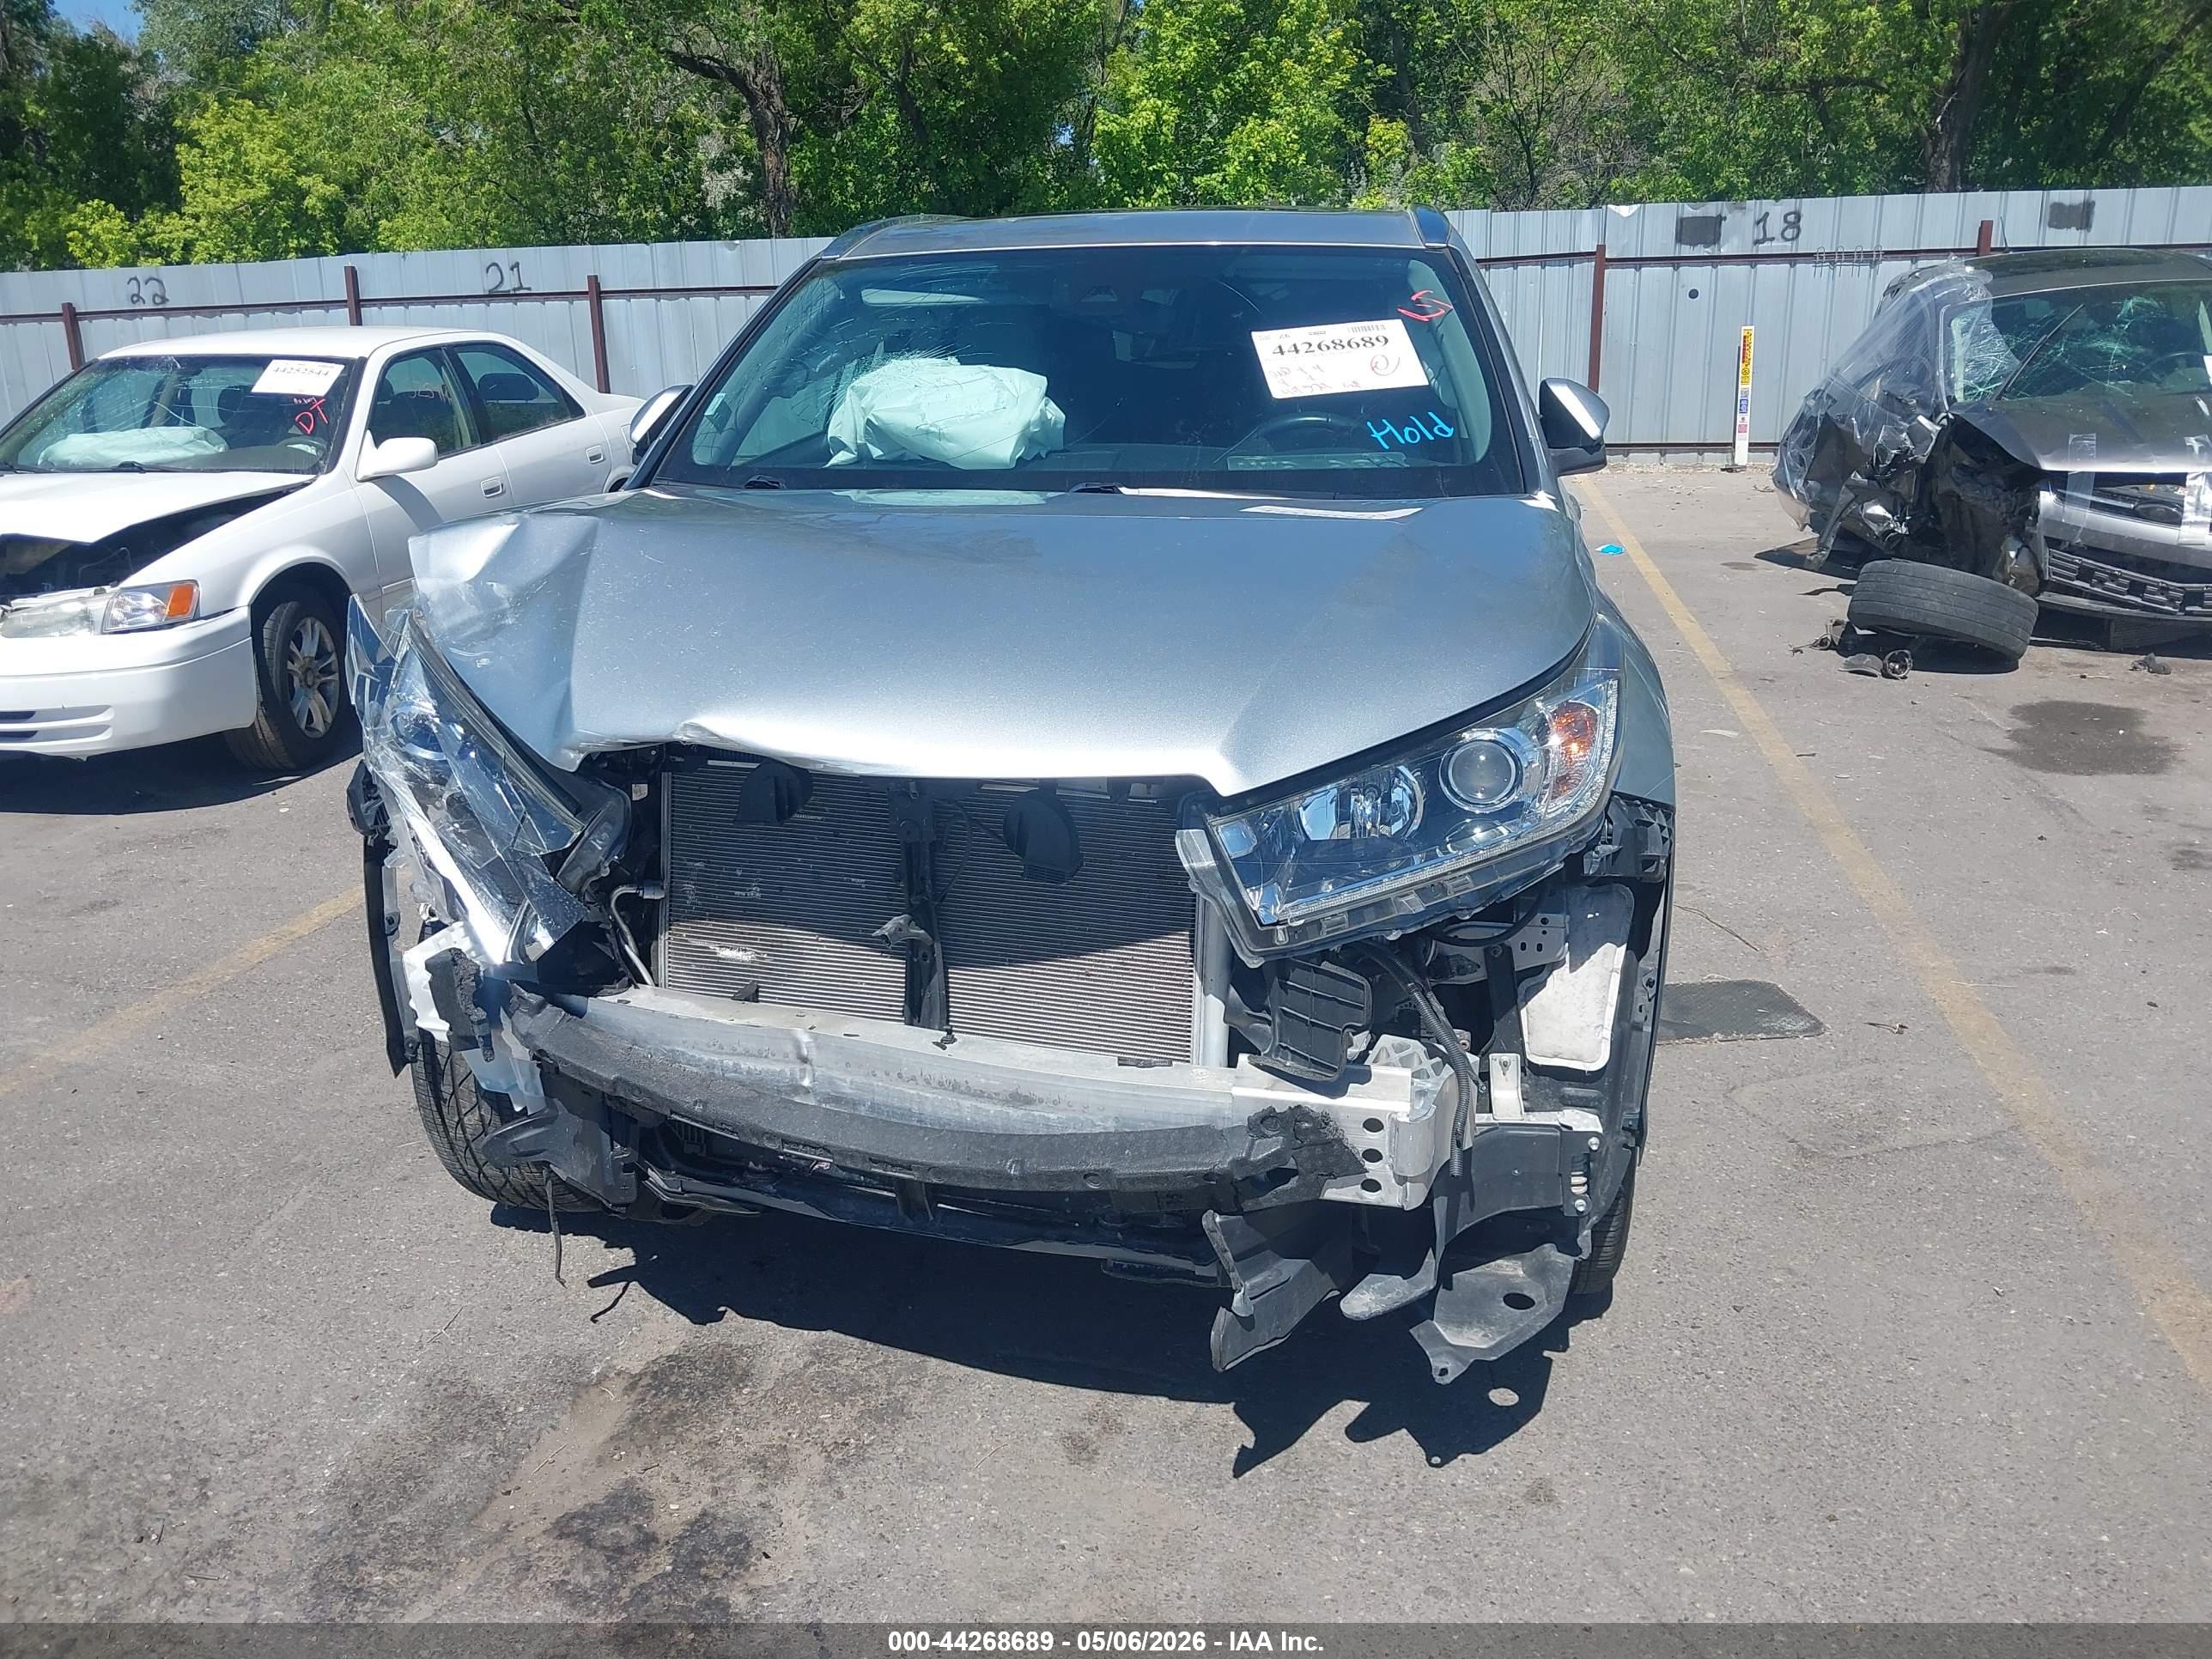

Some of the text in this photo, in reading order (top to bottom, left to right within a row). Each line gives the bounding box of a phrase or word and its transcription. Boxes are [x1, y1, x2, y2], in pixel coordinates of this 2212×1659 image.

[1753, 211, 1802, 246] 18
[126, 276, 169, 306] 22
[485, 261, 532, 295] 21
[1272, 334, 1389, 356] 44268689
[1366, 411, 1455, 450] Hold
